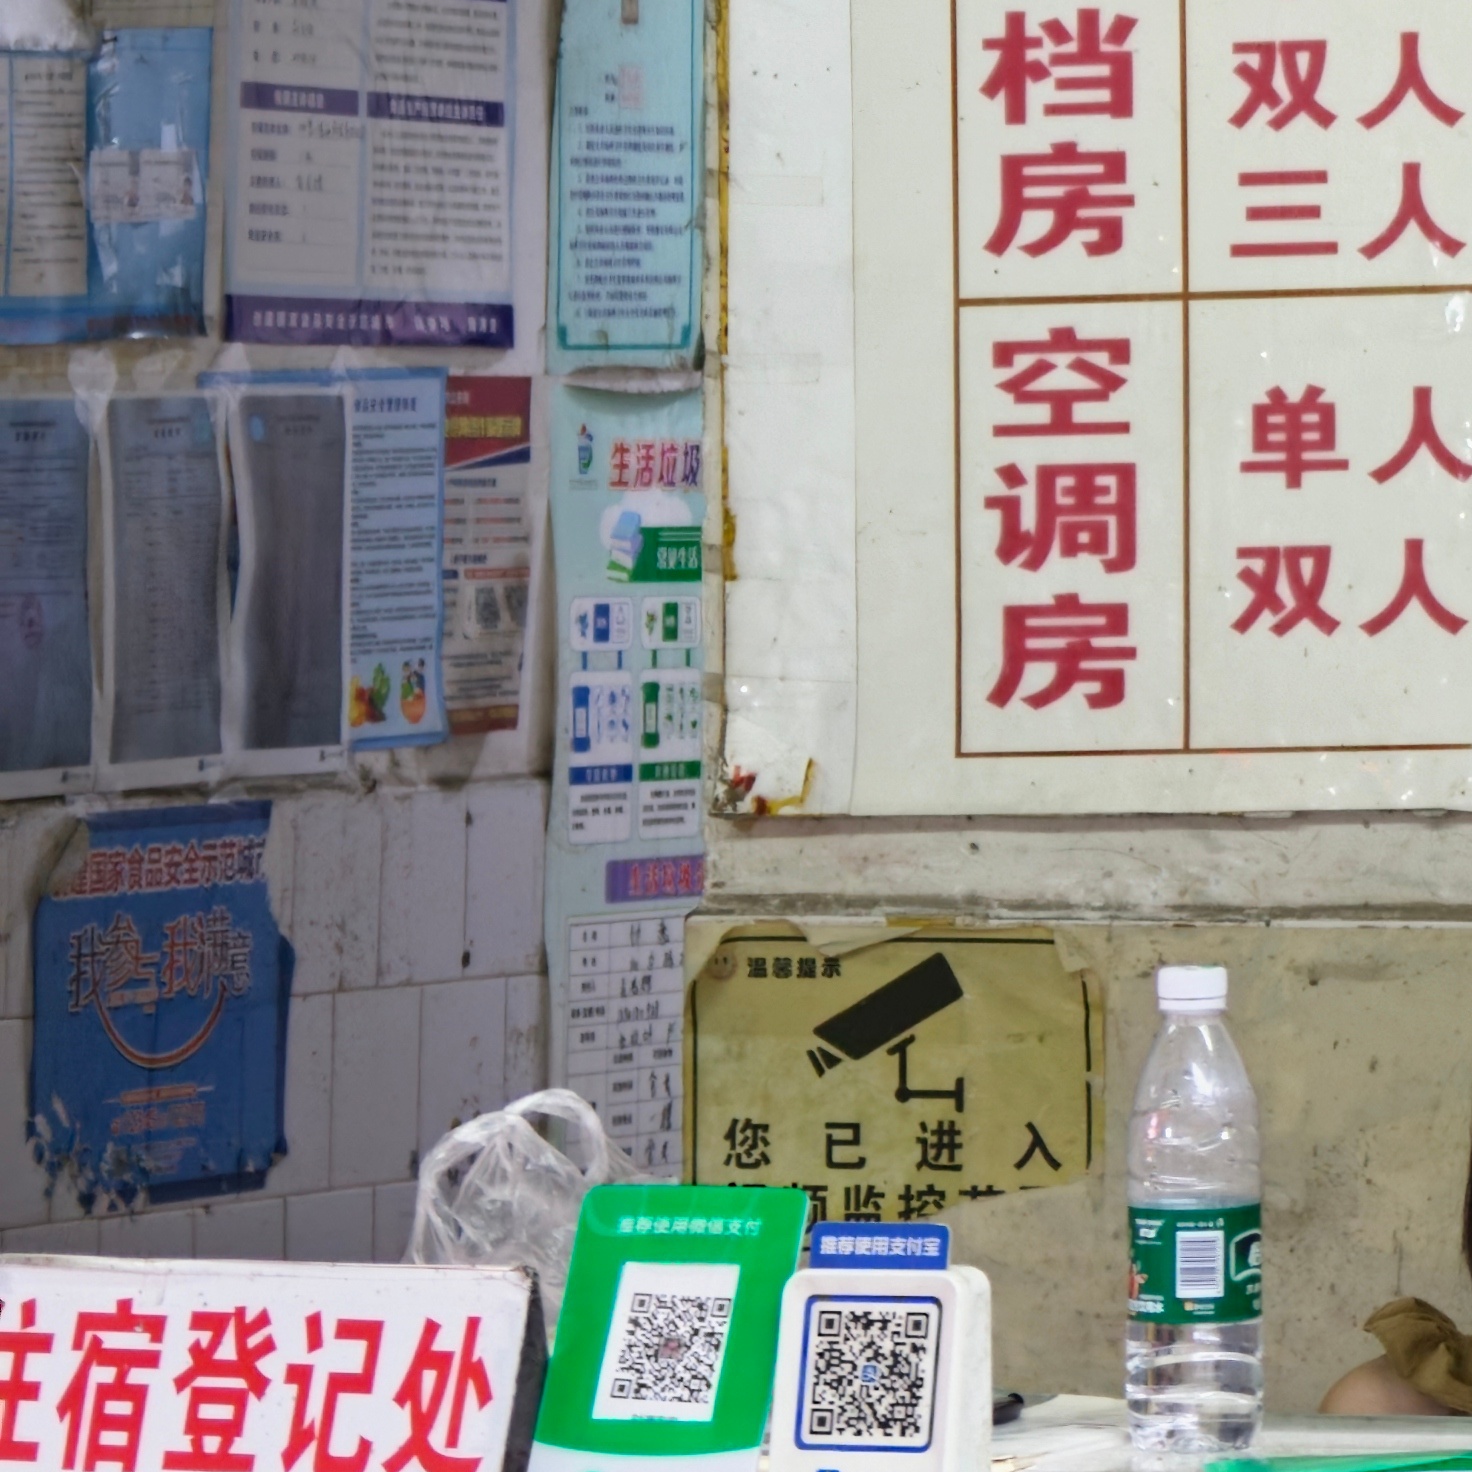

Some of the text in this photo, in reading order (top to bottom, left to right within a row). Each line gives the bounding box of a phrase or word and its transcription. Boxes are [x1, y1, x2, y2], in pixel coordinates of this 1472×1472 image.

[984, 326, 1139, 711] 空调房
[53, 834, 269, 900] 建国家食品安全示范城
[746, 956, 843, 980] 温馨提示
[723, 1117, 1062, 1173] 您已进入
[727, 1181, 1048, 1223] 频监控
